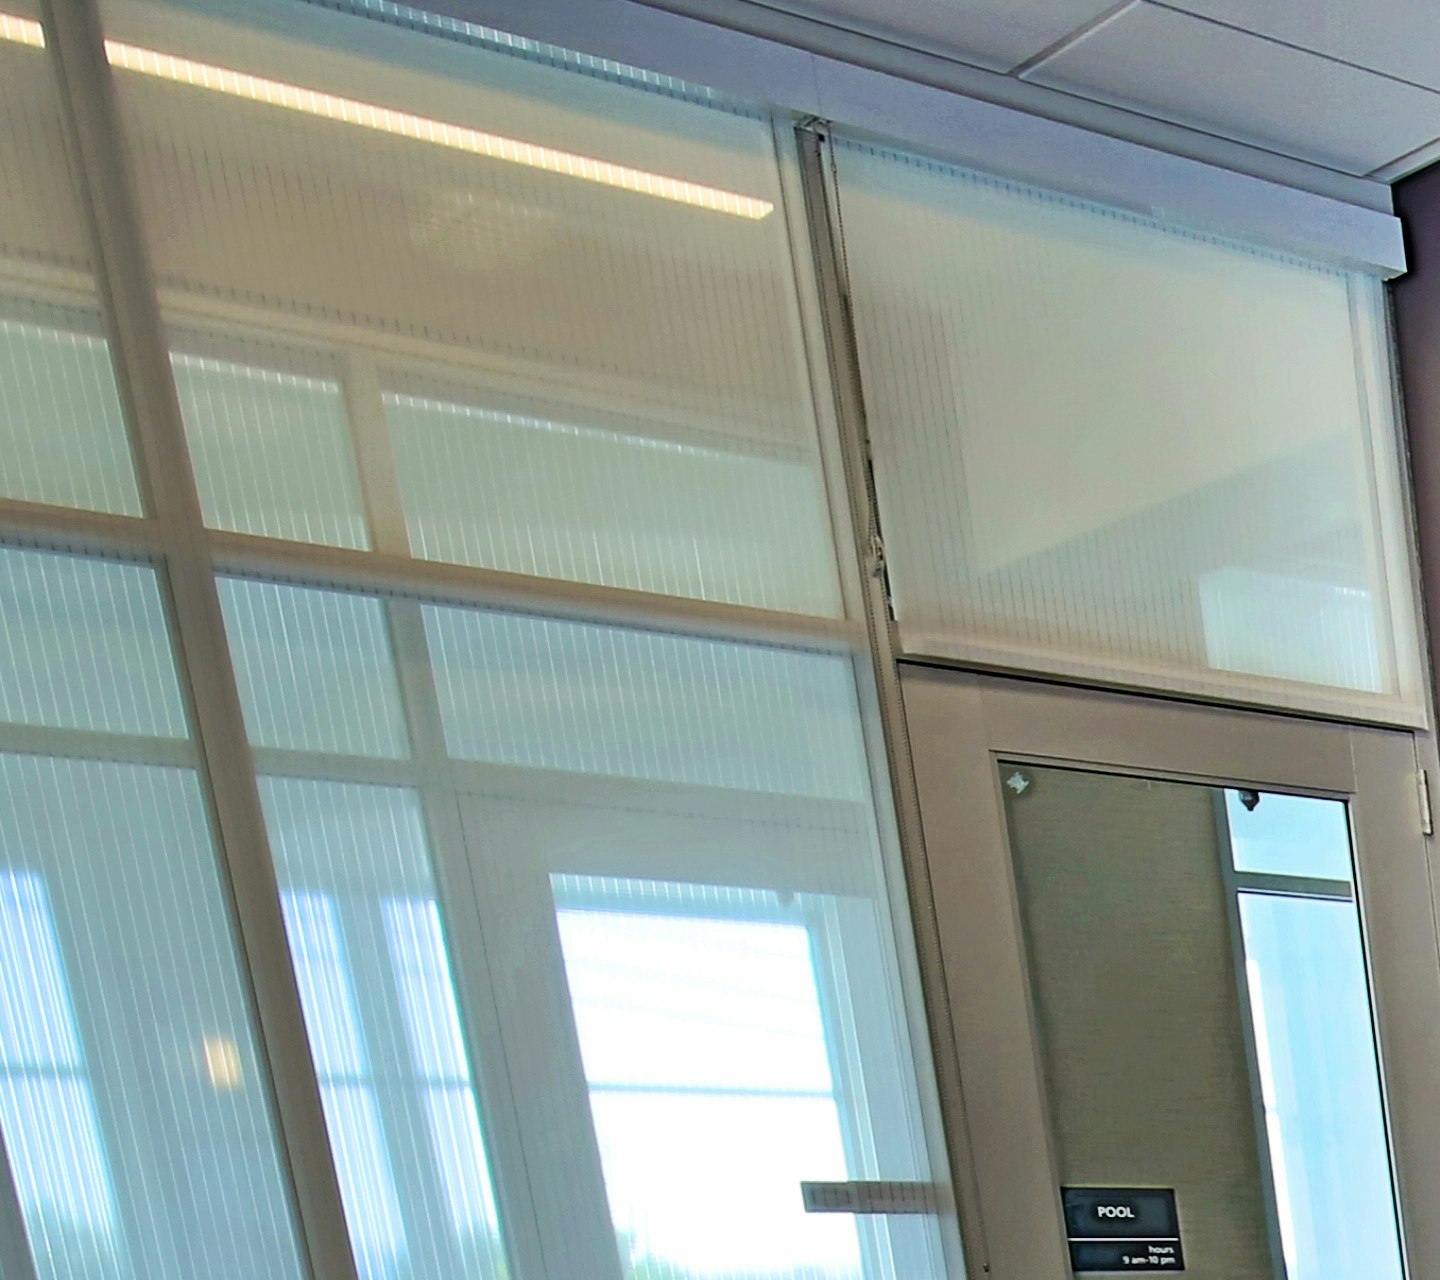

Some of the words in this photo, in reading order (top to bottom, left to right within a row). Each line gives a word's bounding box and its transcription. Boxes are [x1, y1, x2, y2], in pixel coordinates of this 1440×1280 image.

[1097, 1206, 1135, 1218] POOL
[1148, 1245, 1174, 1253] hours
[1122, 1255, 1130, 1264] 9
[1160, 1257, 1175, 1265] pm
